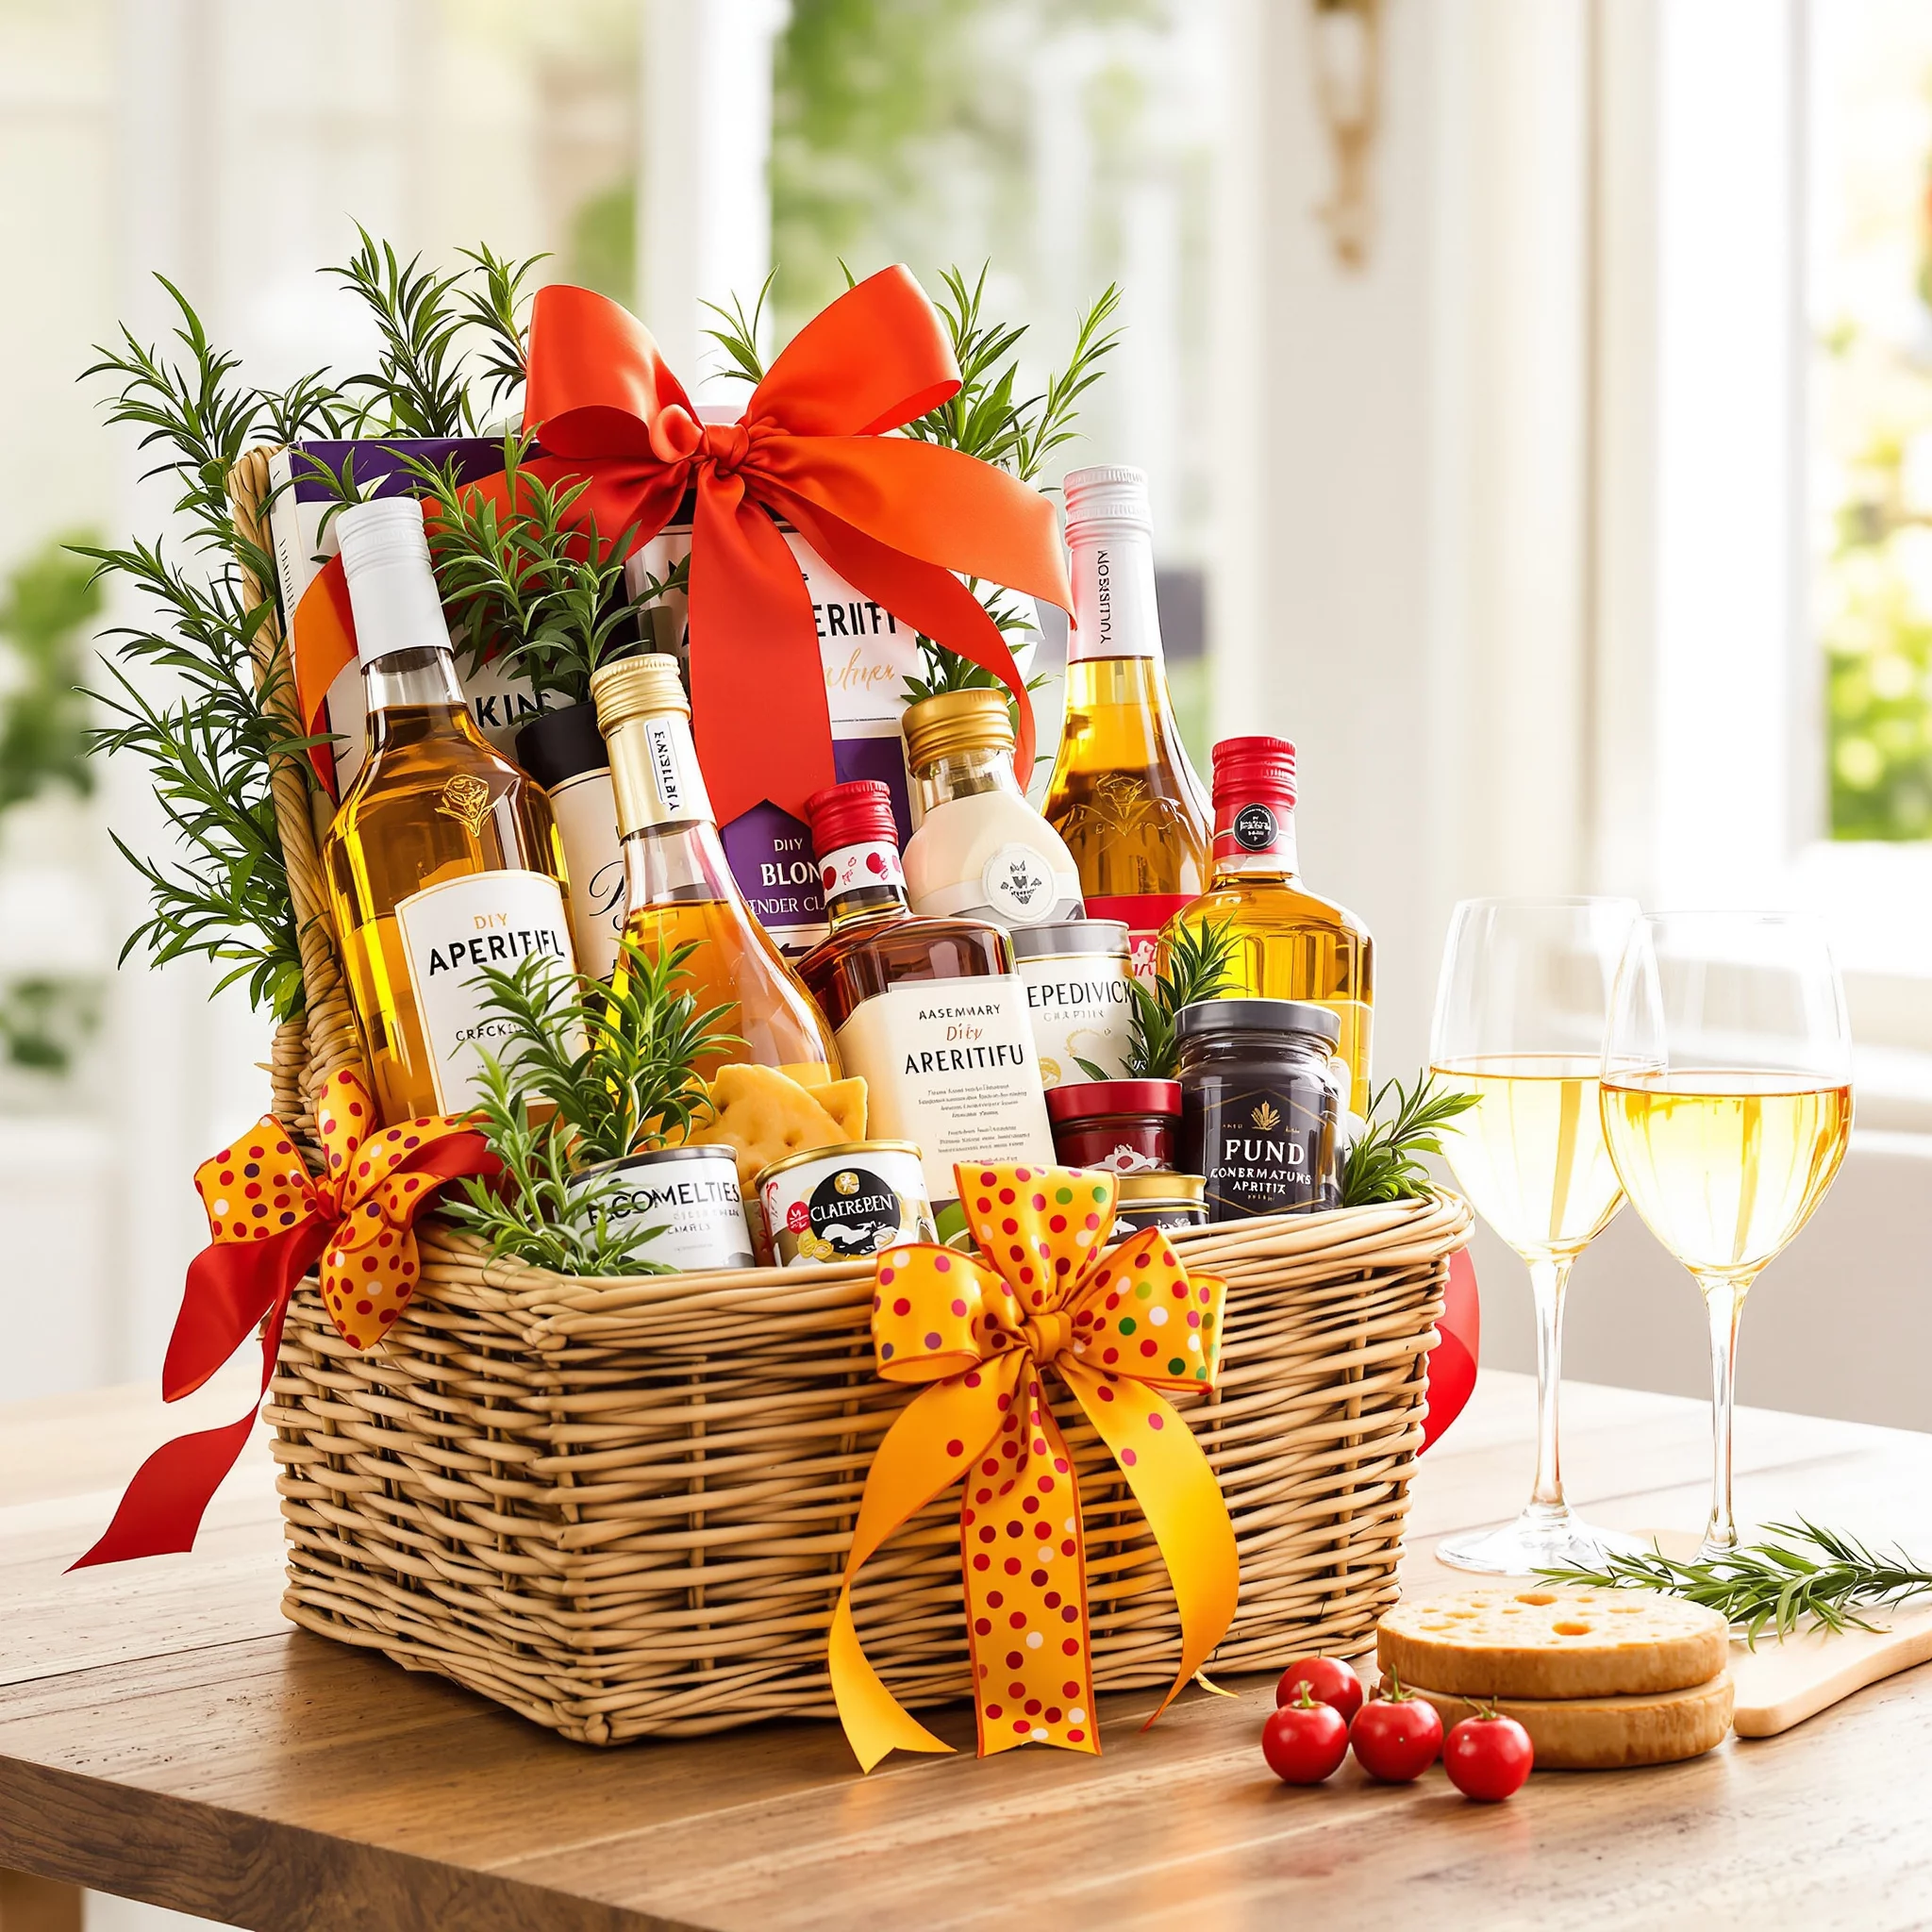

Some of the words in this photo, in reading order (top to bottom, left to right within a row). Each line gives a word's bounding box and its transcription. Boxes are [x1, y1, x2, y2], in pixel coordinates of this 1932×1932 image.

[474, 912, 508, 930] DIY
[905, 1043, 1024, 1075] ARERITIFU
[1224, 1138, 1306, 1166] FUND
